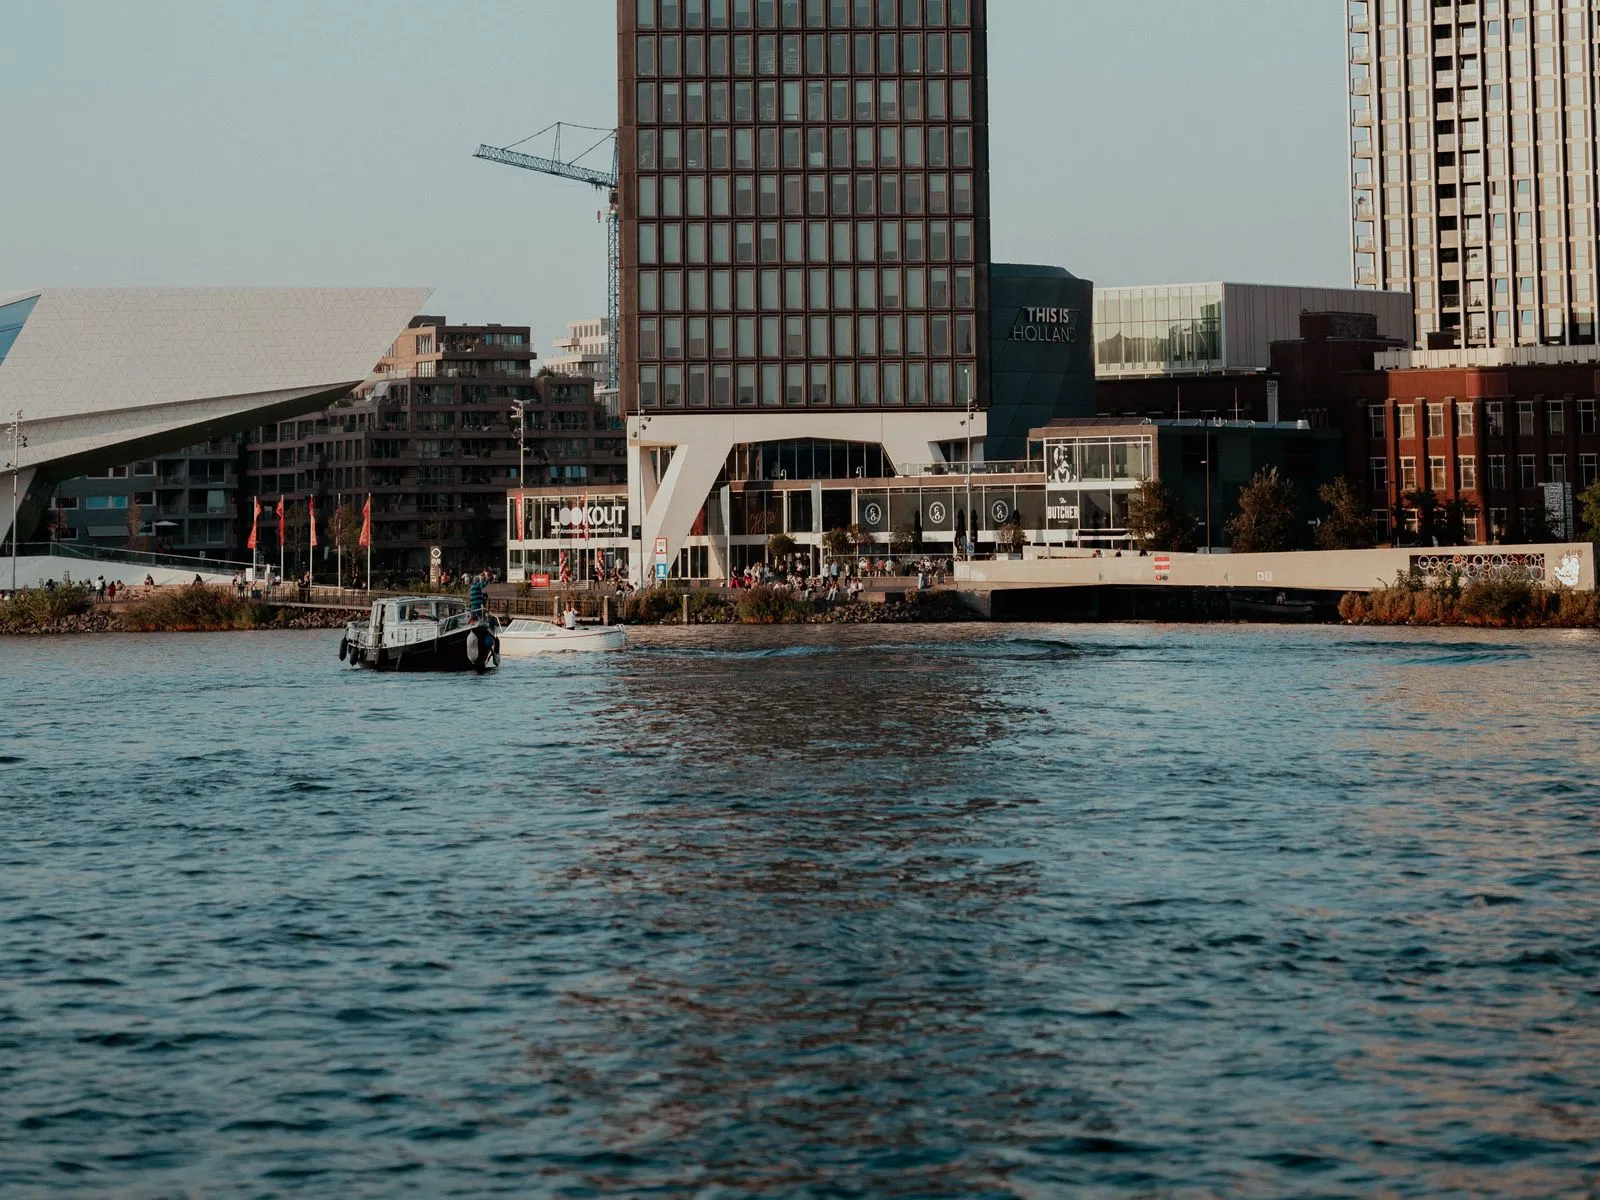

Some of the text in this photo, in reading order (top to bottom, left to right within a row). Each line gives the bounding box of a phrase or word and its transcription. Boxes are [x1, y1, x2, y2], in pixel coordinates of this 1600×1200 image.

[1027, 307, 1069, 323] THIS IS
[1013, 325, 1077, 342] HOLLAND
[550, 506, 626, 526] LOOKOUT
[1047, 505, 1080, 519] BUTCHER
